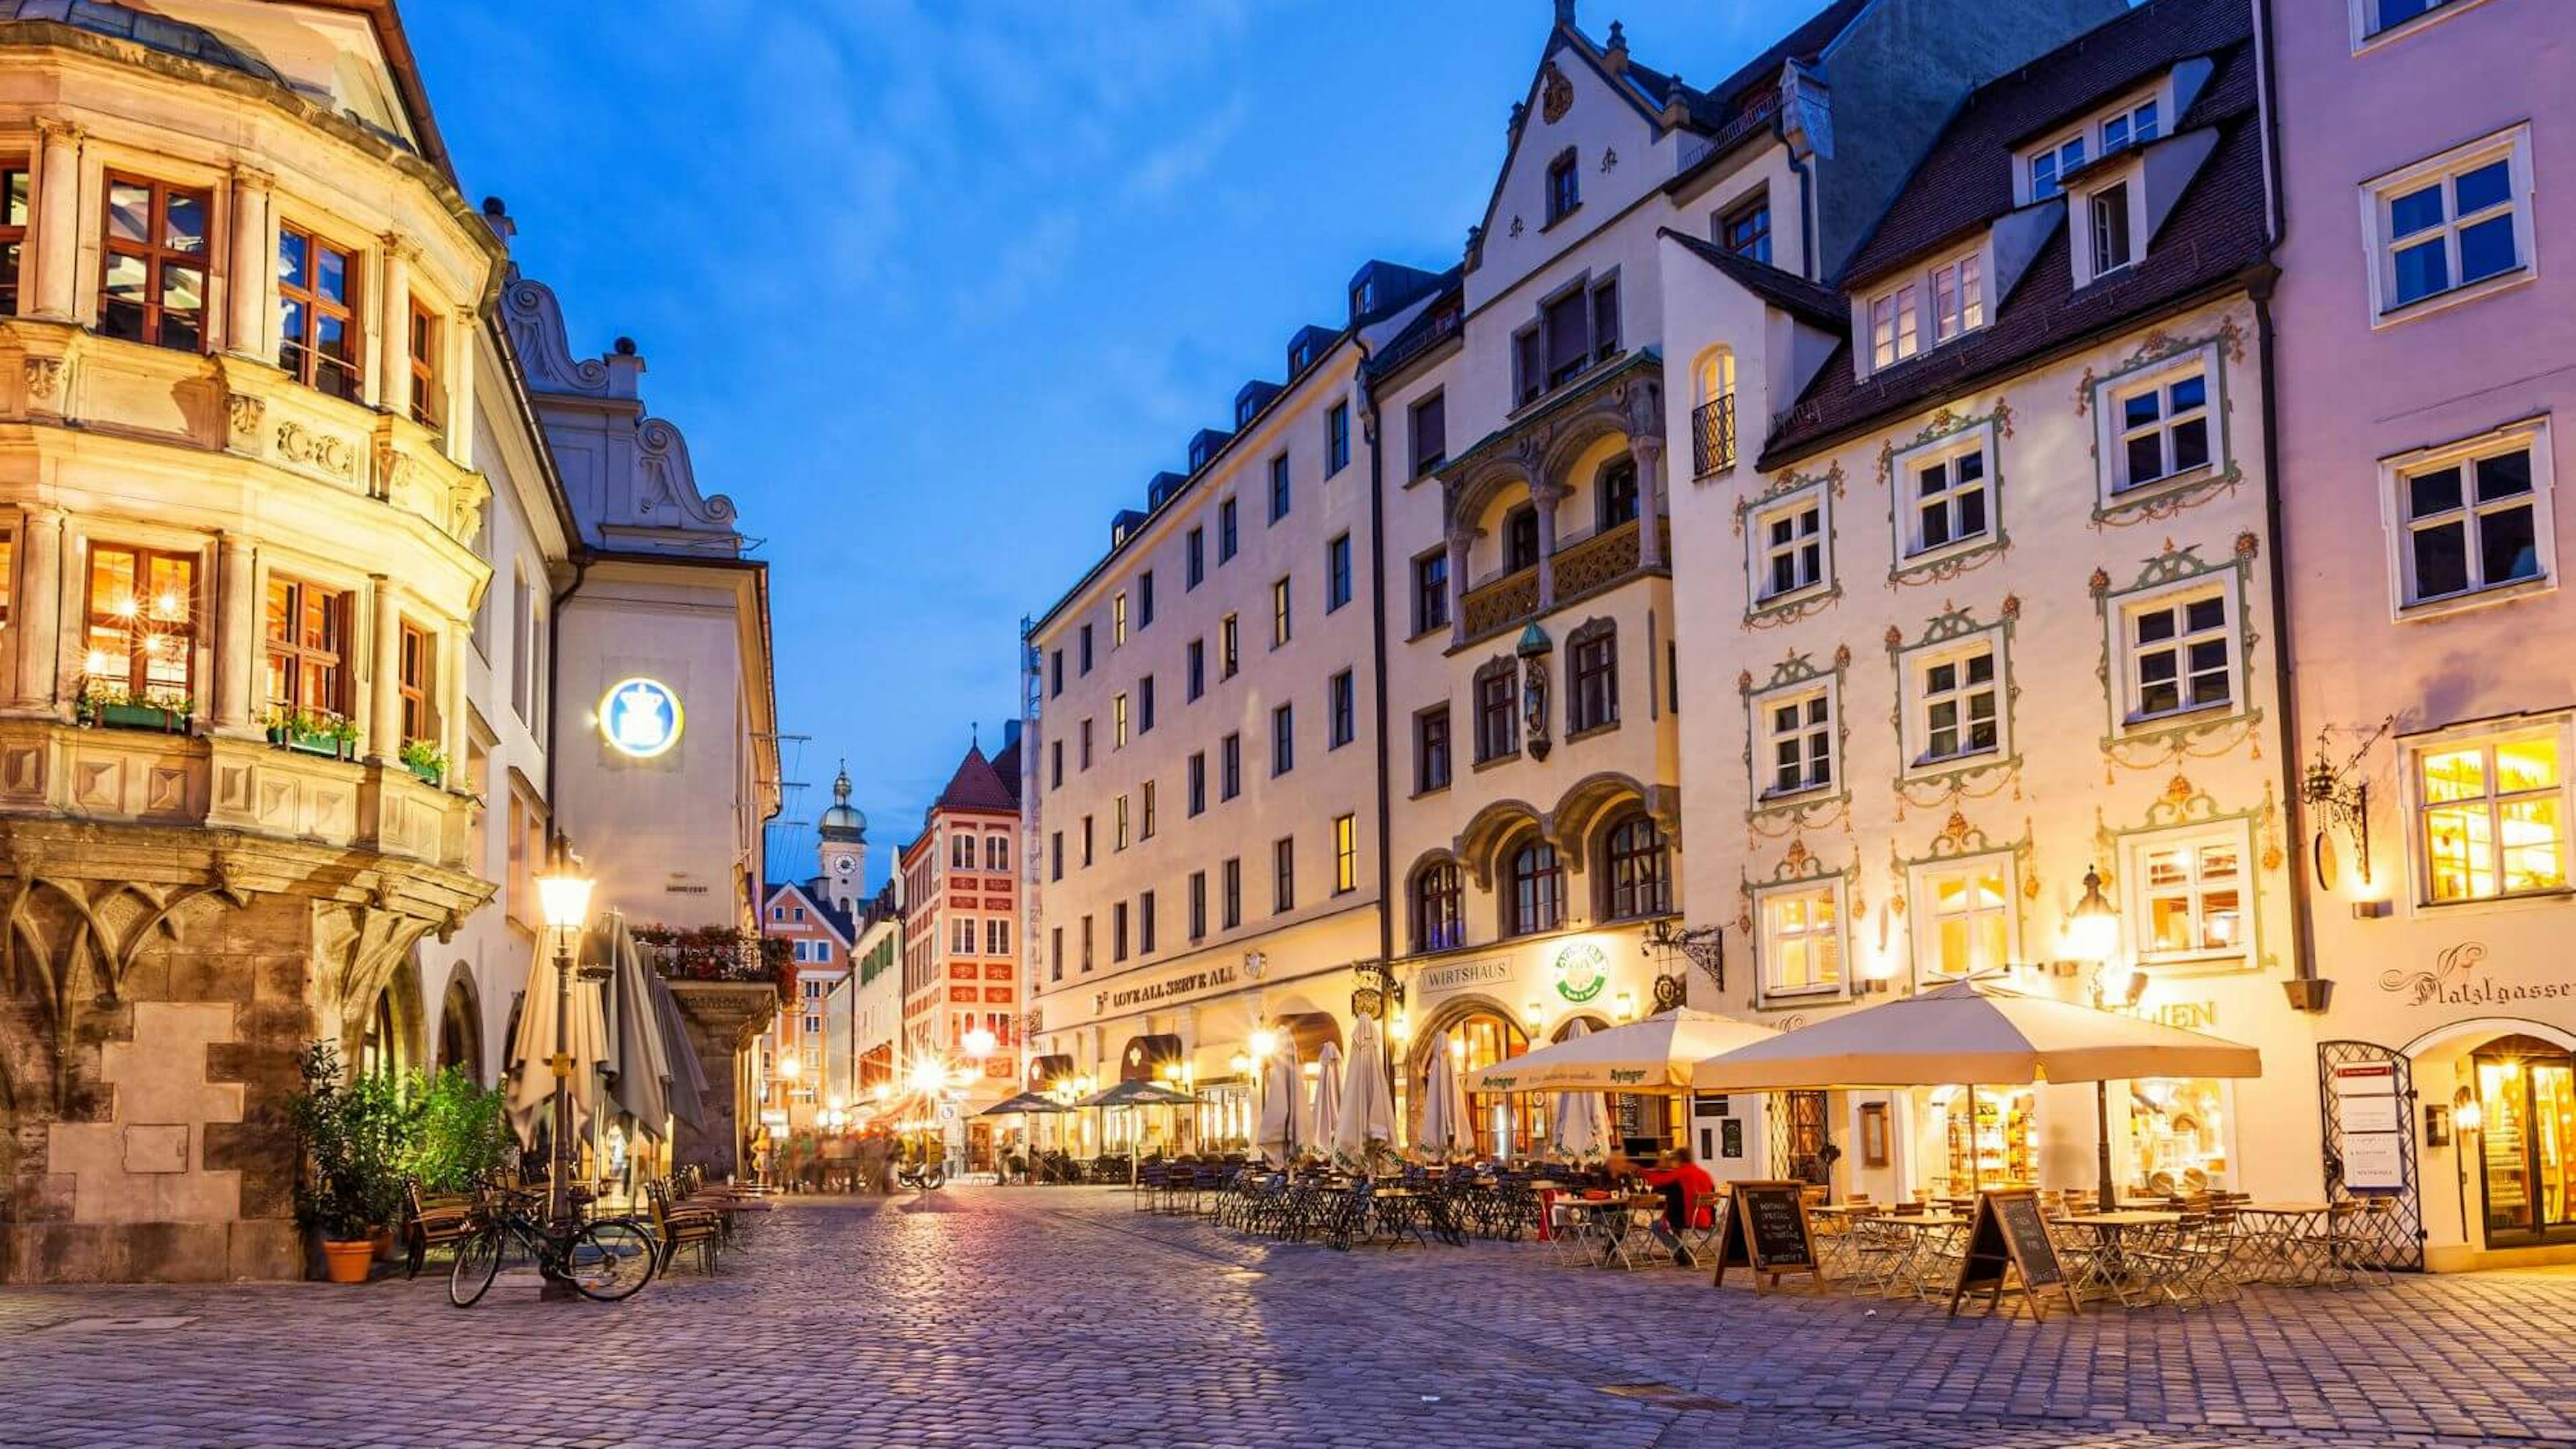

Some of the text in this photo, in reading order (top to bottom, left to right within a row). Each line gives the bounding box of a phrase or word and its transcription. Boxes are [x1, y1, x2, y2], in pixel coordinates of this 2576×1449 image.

[1429, 962, 1507, 987] WIRTSHAUS
[1113, 992, 1140, 1008] LOVE
[1141, 984, 1165, 1002] ALL
[1165, 973, 1207, 994] SERVE
[1209, 966, 1237, 987] ALL
[1481, 1076, 1517, 1090] Ayinger
[1609, 1068, 1647, 1084] Ayinger
